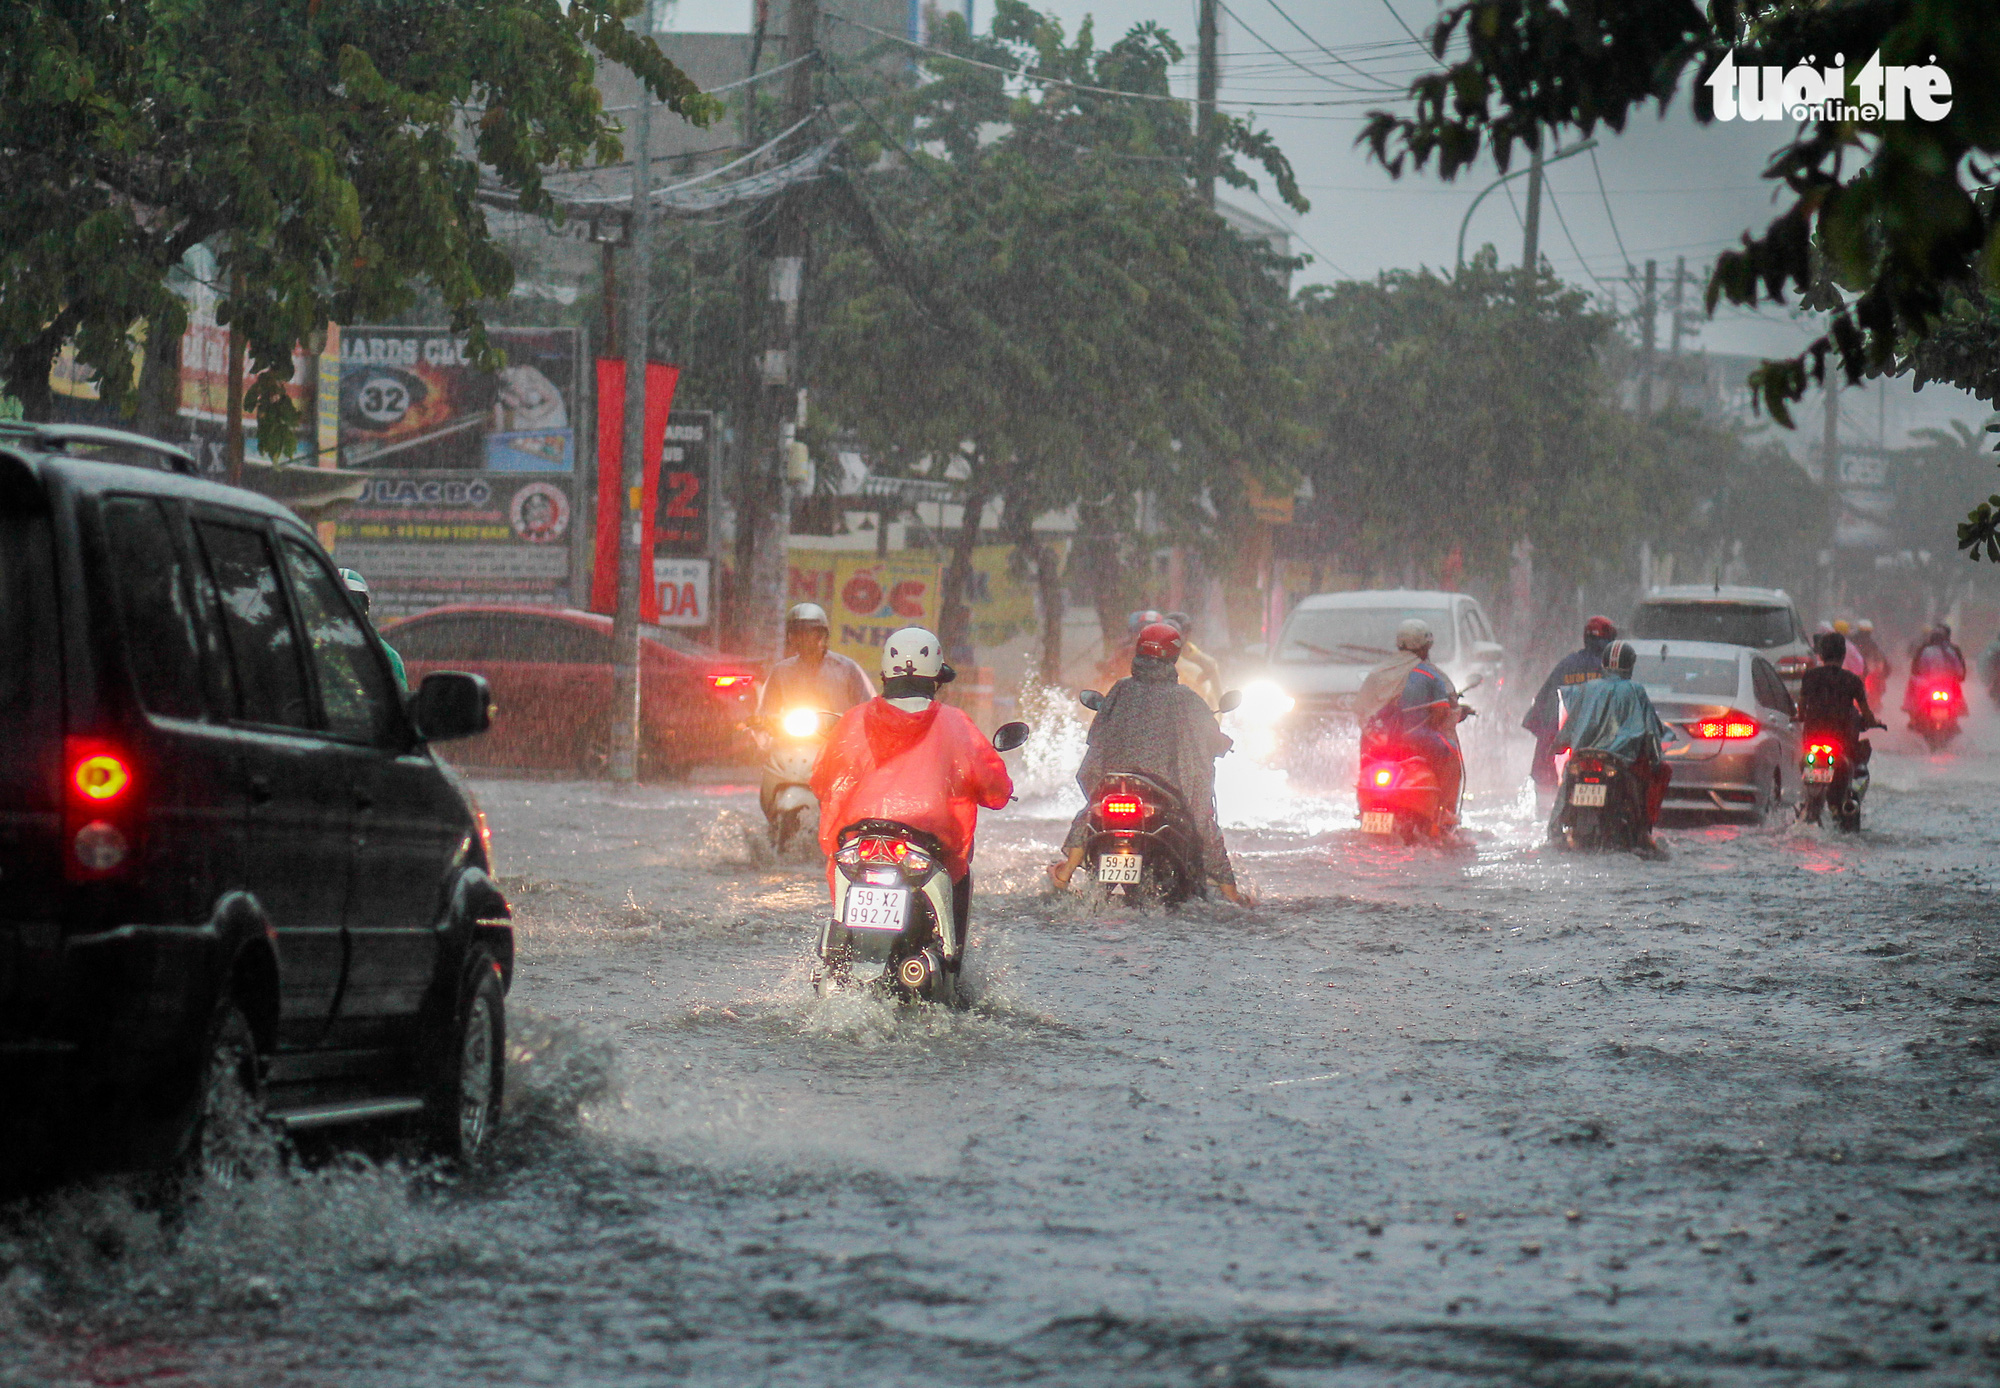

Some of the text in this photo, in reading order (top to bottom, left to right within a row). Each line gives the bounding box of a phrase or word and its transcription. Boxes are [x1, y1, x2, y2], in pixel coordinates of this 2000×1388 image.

[364, 386, 404, 413] 32
[666, 472, 699, 518] 2
[658, 581, 699, 617] DA
[1106, 856, 1136, 868] 59-X3
[1101, 869, 1138, 881] 127.67
[857, 890, 899, 907] 59-X2
[850, 907, 900, 925] 992.74
